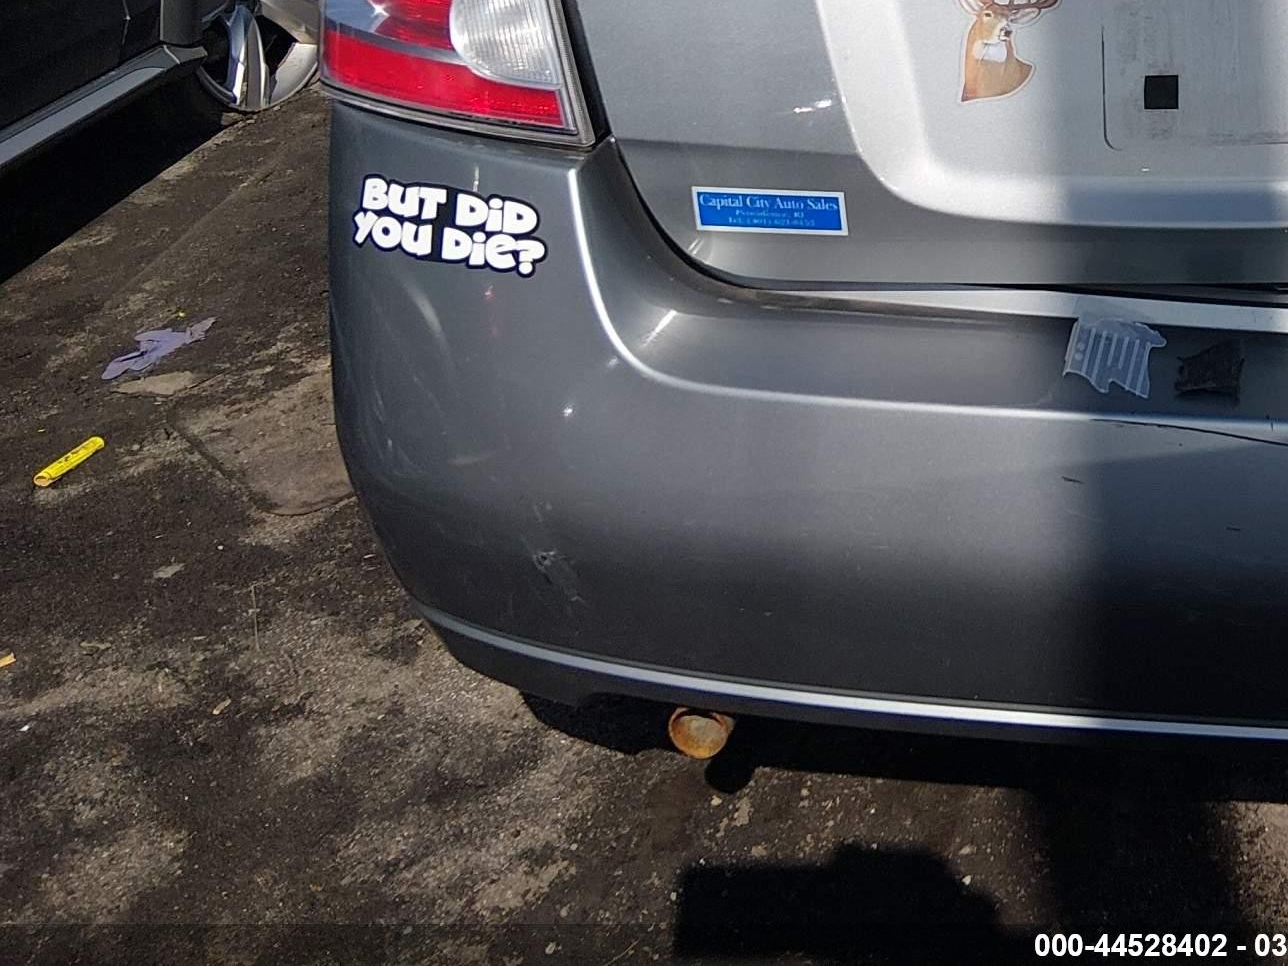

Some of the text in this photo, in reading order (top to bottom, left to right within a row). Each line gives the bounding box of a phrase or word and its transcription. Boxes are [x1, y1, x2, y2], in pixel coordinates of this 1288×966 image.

[362, 177, 448, 221] BUT
[700, 194, 838, 211] Capital City Auto Sales
[354, 210, 433, 256] YOU
